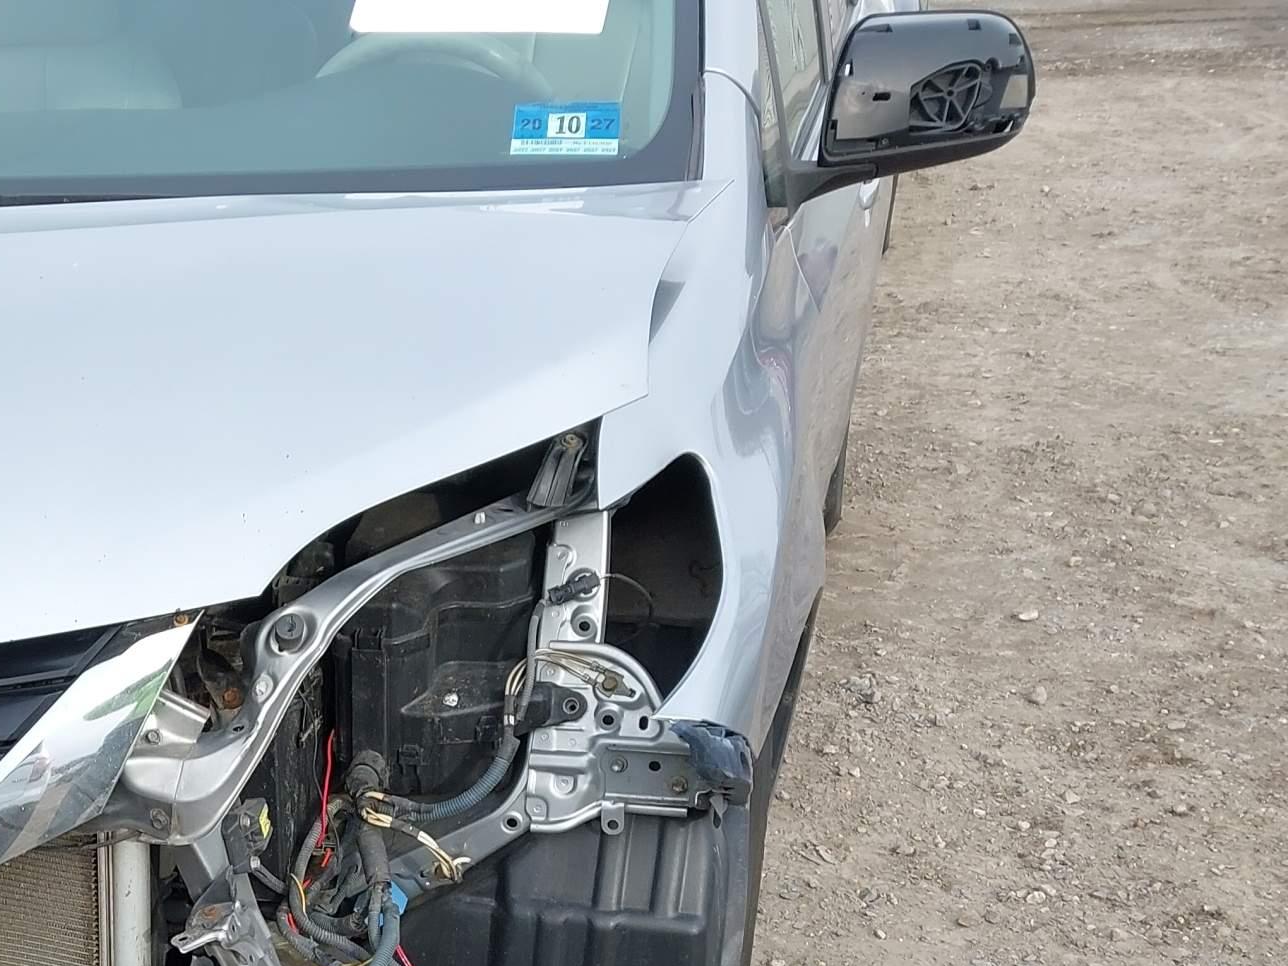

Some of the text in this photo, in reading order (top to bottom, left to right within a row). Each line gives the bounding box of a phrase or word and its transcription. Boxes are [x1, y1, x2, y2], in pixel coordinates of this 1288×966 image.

[520, 115, 616, 135] 20 10 27
